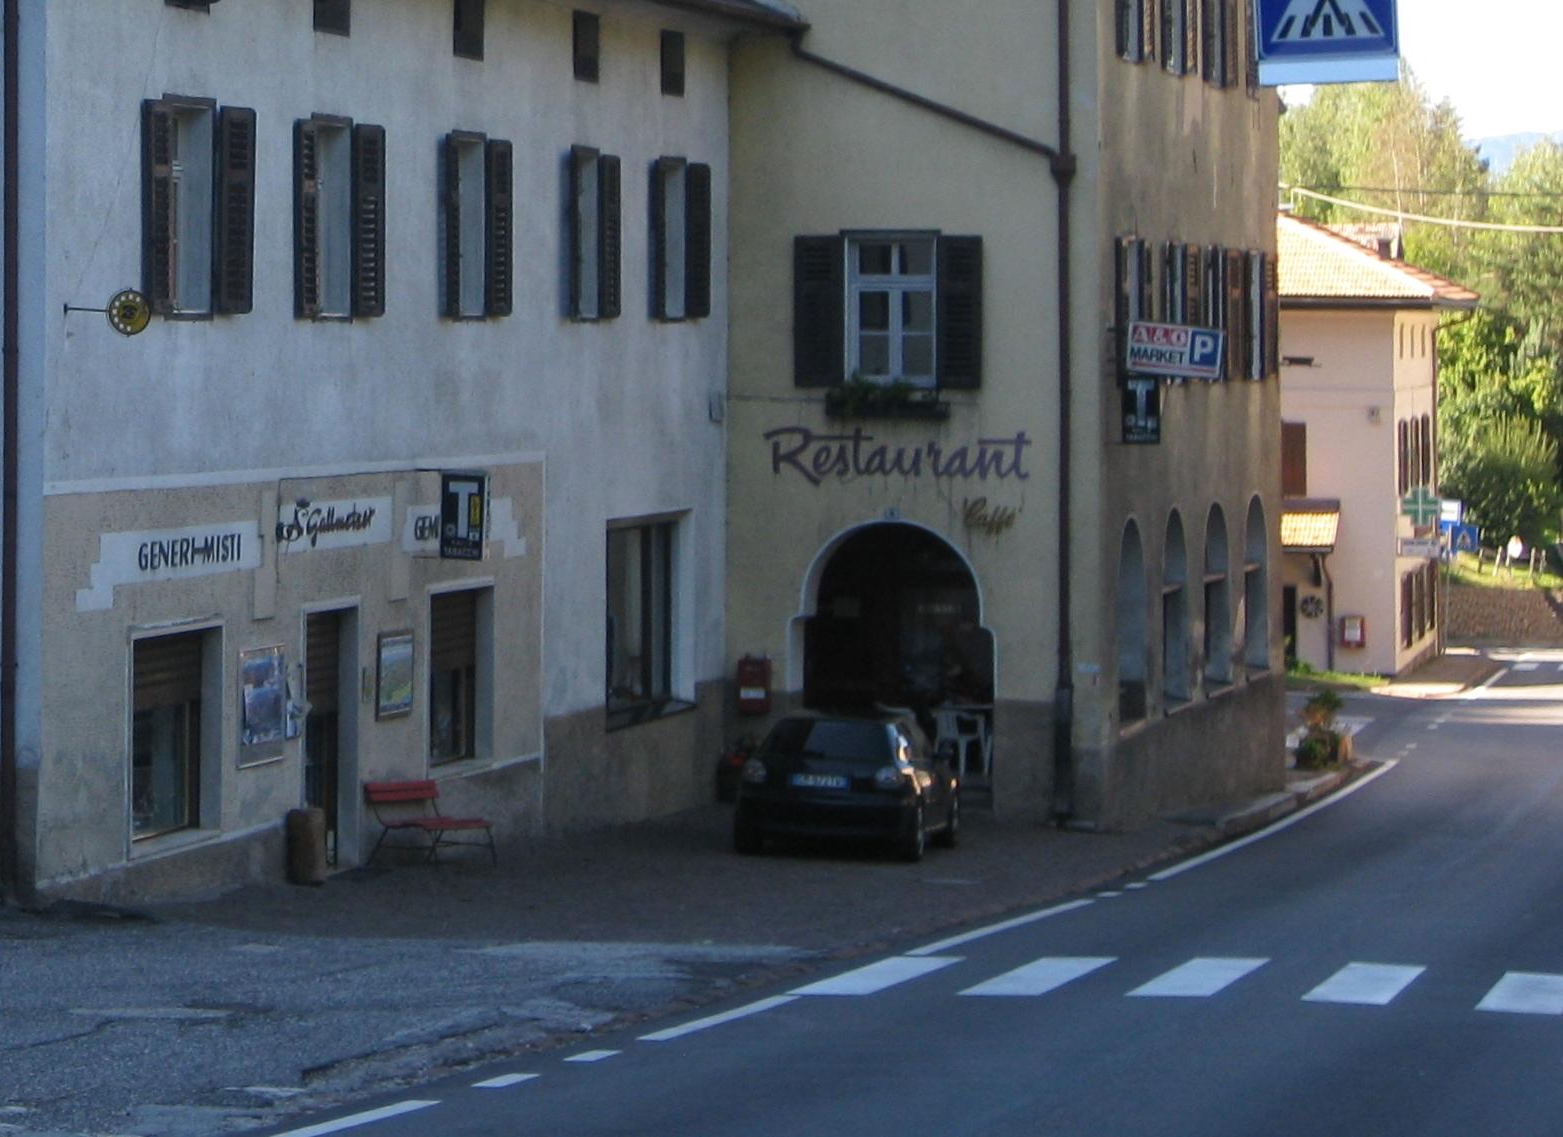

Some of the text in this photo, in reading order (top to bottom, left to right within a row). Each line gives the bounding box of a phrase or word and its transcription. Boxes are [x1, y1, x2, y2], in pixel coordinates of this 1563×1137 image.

[1129, 346, 1185, 365] MARKET
[1194, 334, 1215, 363] P
[762, 427, 1033, 486] Restaurant
[448, 481, 479, 539] T
[138, 533, 242, 571] GENERI-MISTI
